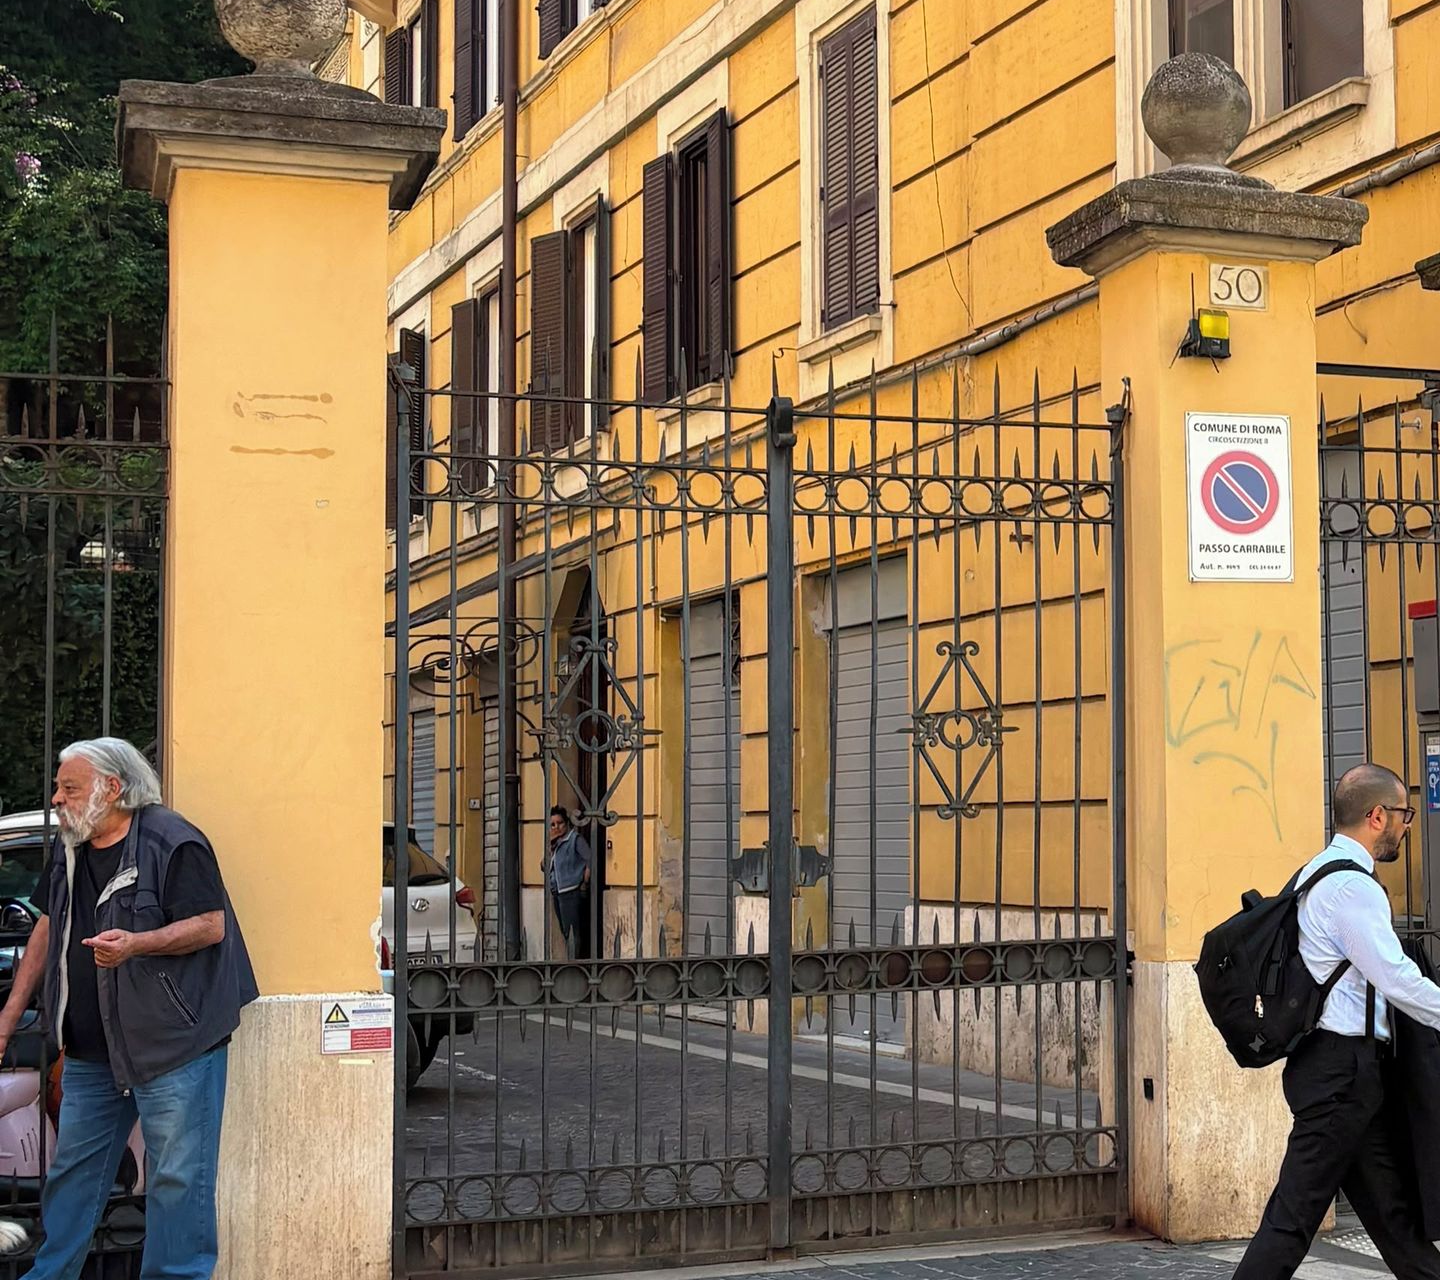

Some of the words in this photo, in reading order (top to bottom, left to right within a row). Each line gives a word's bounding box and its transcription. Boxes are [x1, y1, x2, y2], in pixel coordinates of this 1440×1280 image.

[1214, 266, 1262, 303] 50
[1193, 423, 1237, 433] COMUNE
[1240, 425, 1250, 433] DI
[1252, 425, 1282, 434] ROMA
[1199, 543, 1231, 553] PASSO
[1233, 545, 1286, 554] CARRABILE
